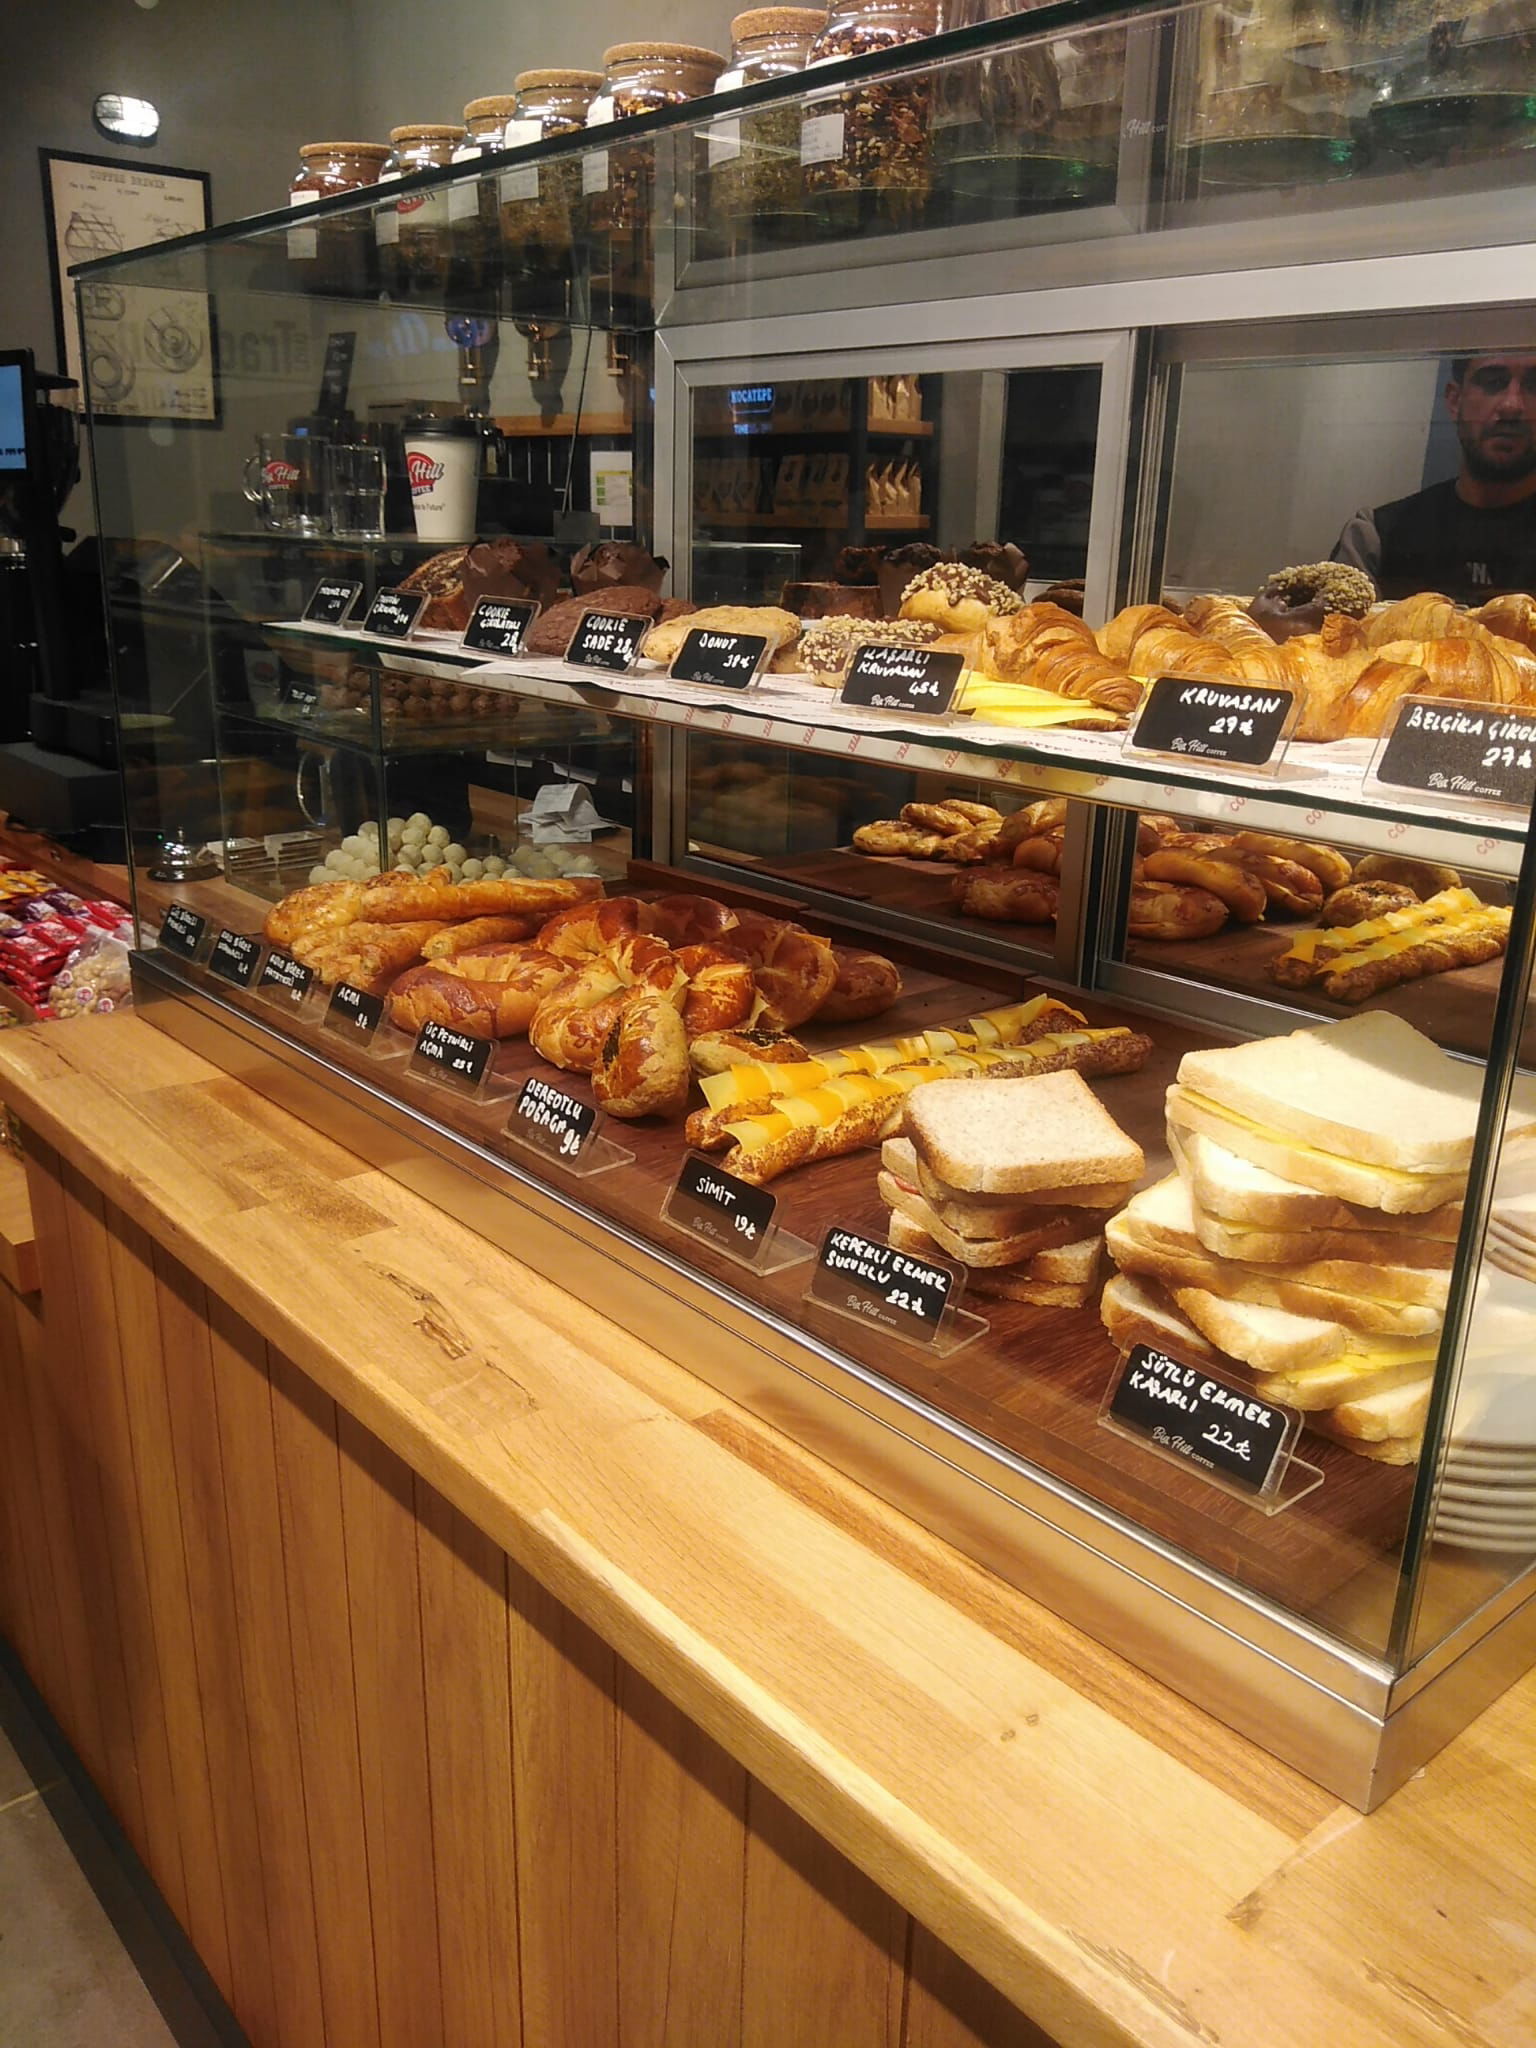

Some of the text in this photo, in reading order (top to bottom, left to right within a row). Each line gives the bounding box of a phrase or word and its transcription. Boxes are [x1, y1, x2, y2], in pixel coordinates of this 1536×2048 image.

[411, 460, 445, 482] Hill
[478, 604, 511, 620] COOKIE
[586, 615, 629, 632] COOKIE
[582, 633, 615, 651] SADE
[698, 632, 738, 650] DONUT
[1179, 687, 1281, 714] KRUVASAN
[1449, 775, 1477, 791] Hill
[1474, 787, 1502, 796] COFFEE
[526, 1079, 583, 1120] DEREOTLU
[696, 1176, 736, 1206] SİMİT
[826, 1249, 891, 1284] SUCUKLU
[831, 1232, 946, 1292] KEPEKLİ EKMEK
[1141, 1351, 1272, 1428] SÜTLÜ EKMEK
[1171, 1434, 1194, 1455] Hill
[1191, 1452, 1215, 1469] COFFEE
